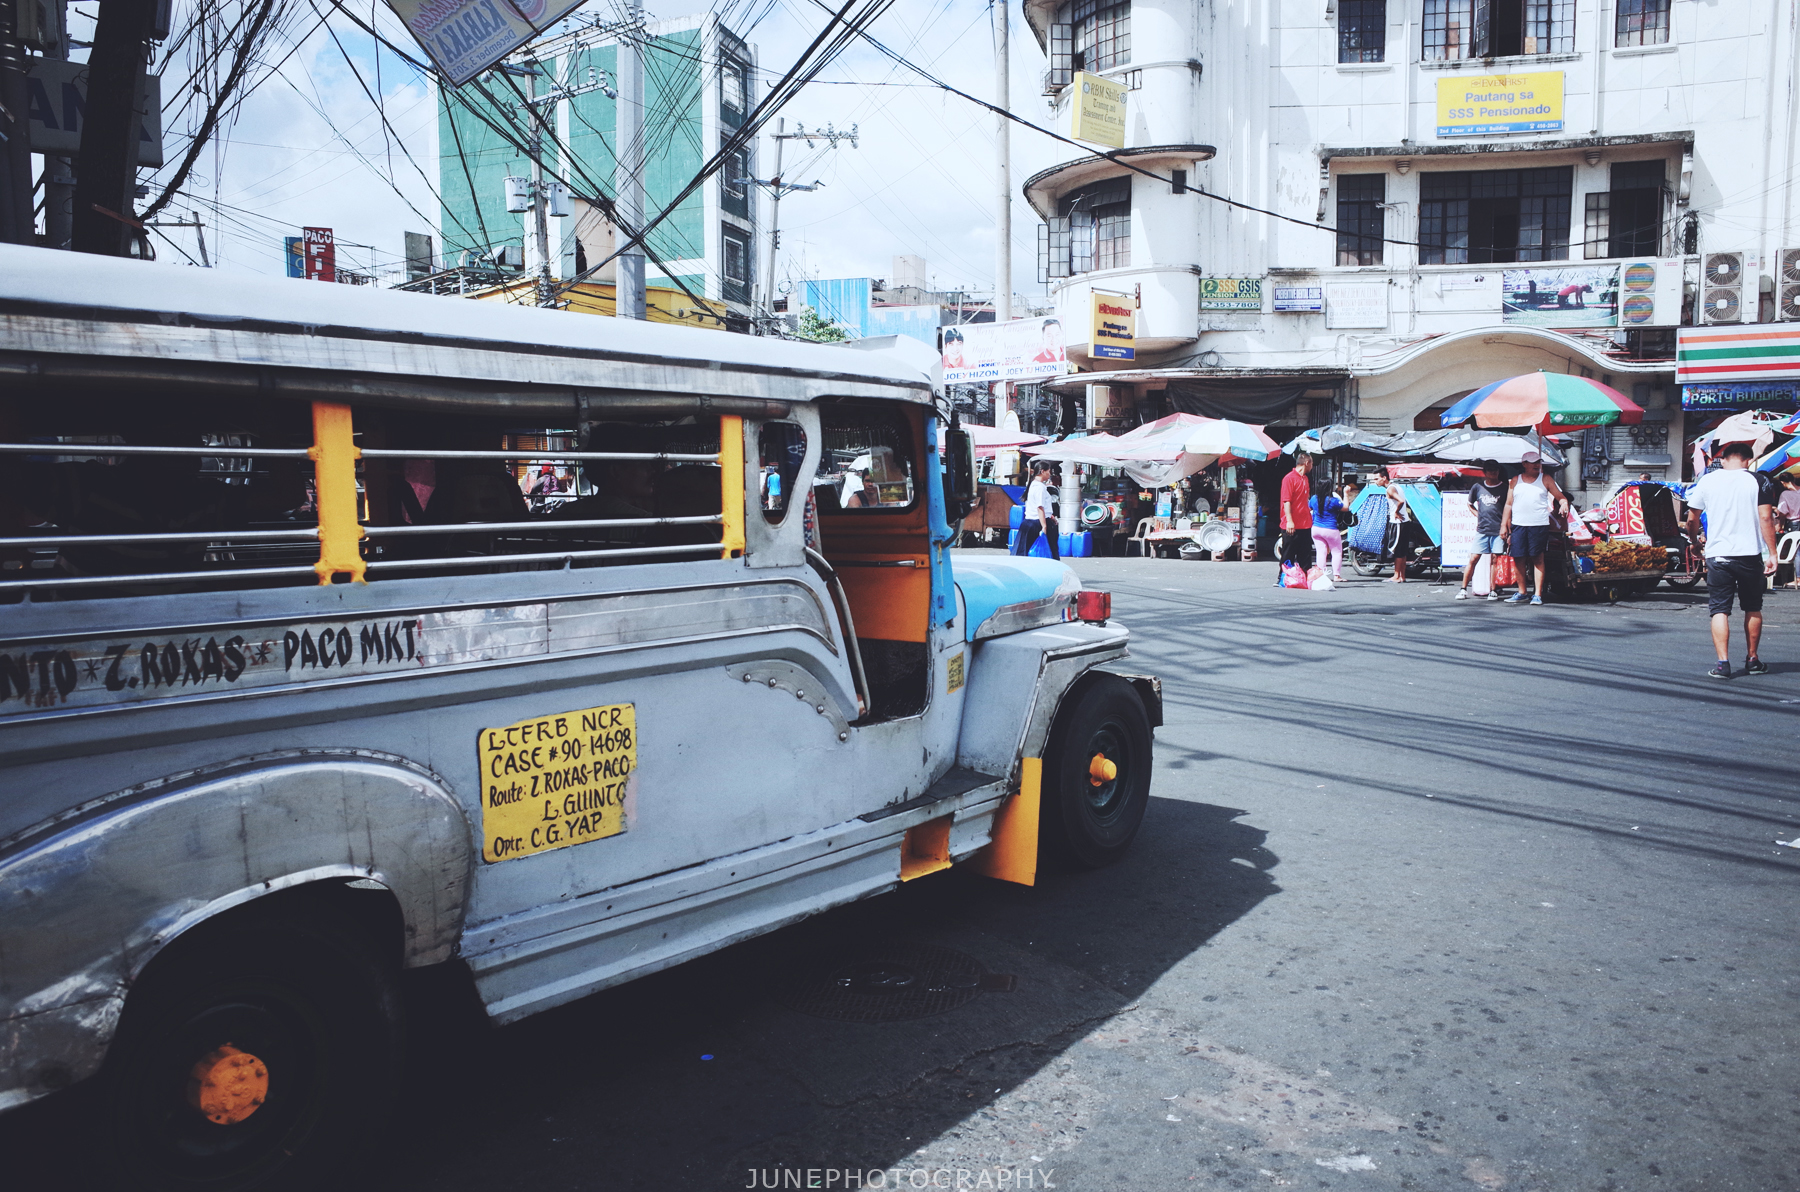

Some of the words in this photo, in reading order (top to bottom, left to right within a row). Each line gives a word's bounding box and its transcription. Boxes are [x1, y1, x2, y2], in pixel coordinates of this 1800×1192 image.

[1465, 92, 1515, 104] Pautang
[1520, 92, 1534, 100] sa
[1448, 108, 1474, 119] SSS
[1480, 104, 1551, 117] Pensionado
[304, 230, 332, 244] PACO
[1218, 280, 1236, 292] SSS
[1238, 280, 1260, 293] GSIS
[944, 372, 969, 380] JOEY
[969, 370, 999, 378] HIZON
[1005, 368, 1024, 376] JOEY
[1026, 366, 1034, 374] TJ
[284, 626, 353, 673] PACO
[488, 718, 568, 752] LTFRB
[582, 708, 623, 732] NCR
[492, 746, 544, 778] CASE
[490, 781, 527, 808] Route:
[494, 836, 525, 857] Optr.
